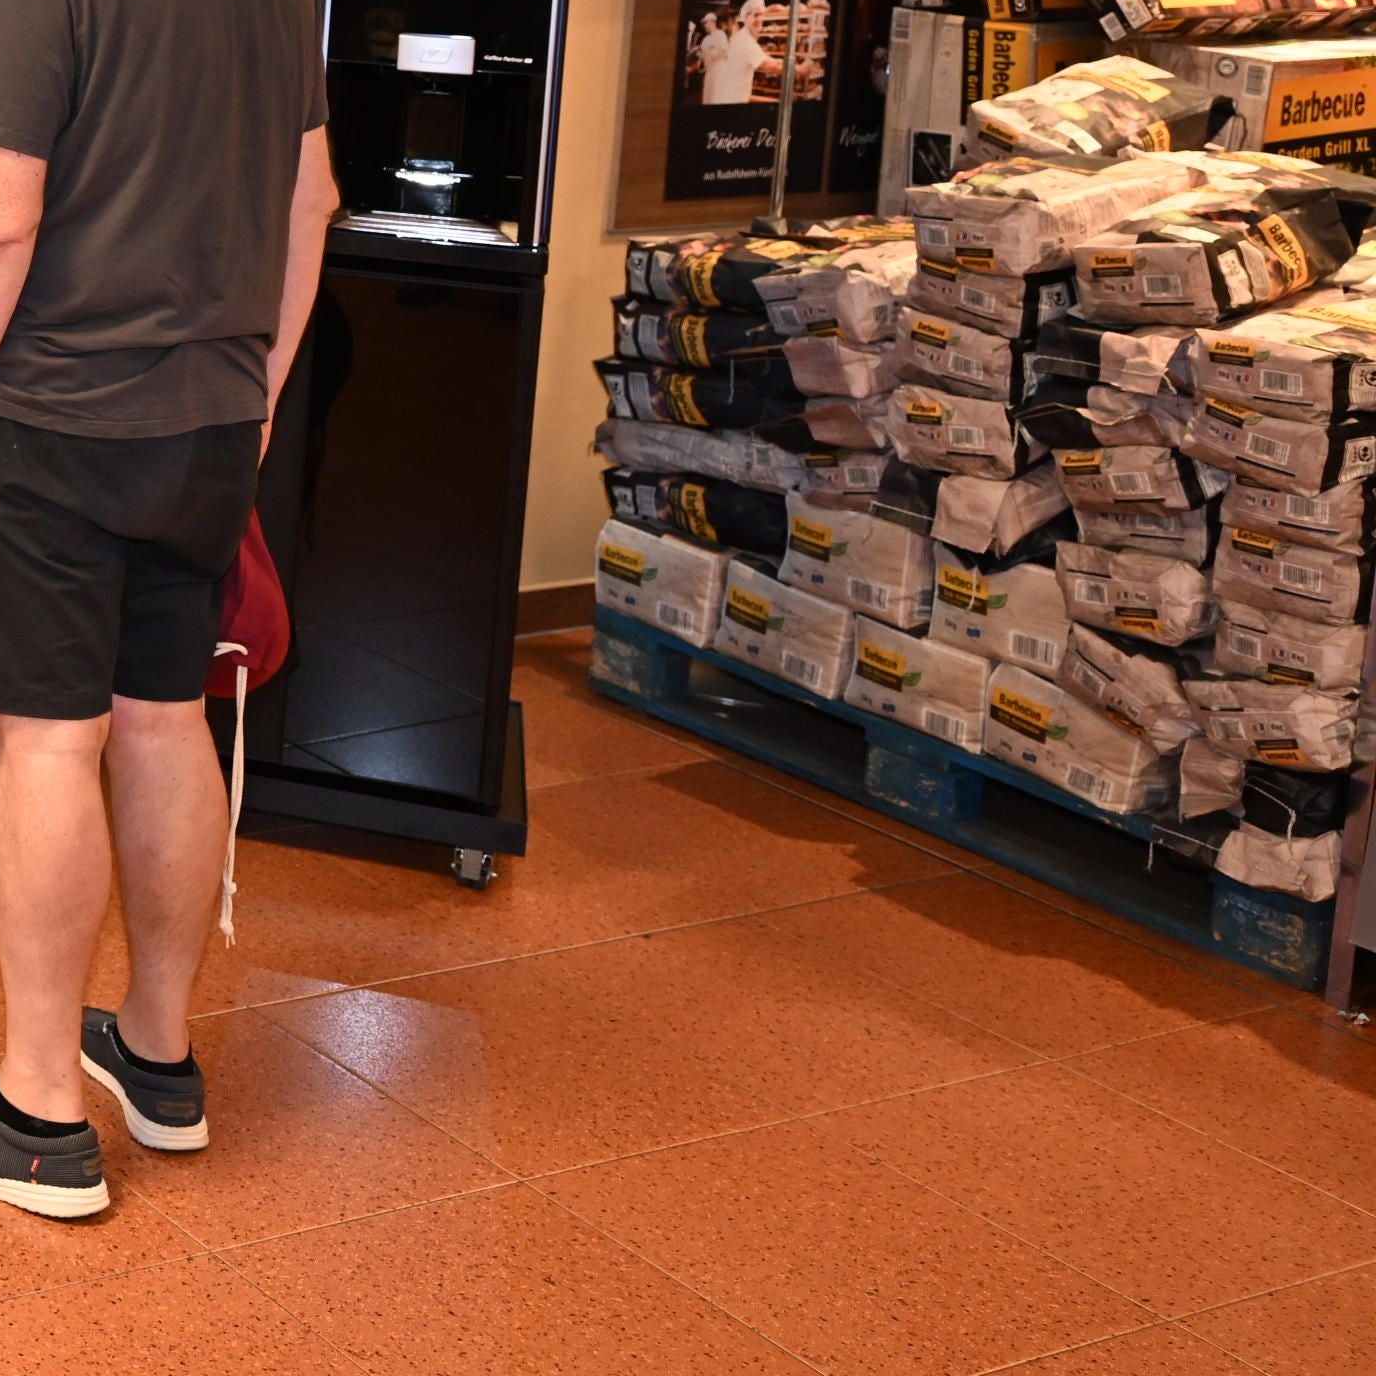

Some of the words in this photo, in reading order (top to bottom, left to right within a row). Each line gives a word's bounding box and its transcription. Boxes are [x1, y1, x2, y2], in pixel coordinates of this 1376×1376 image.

[1279, 87, 1367, 128] Barbecue
[1325, 141, 1353, 155] Grill
[1355, 139, 1371, 152] XL
